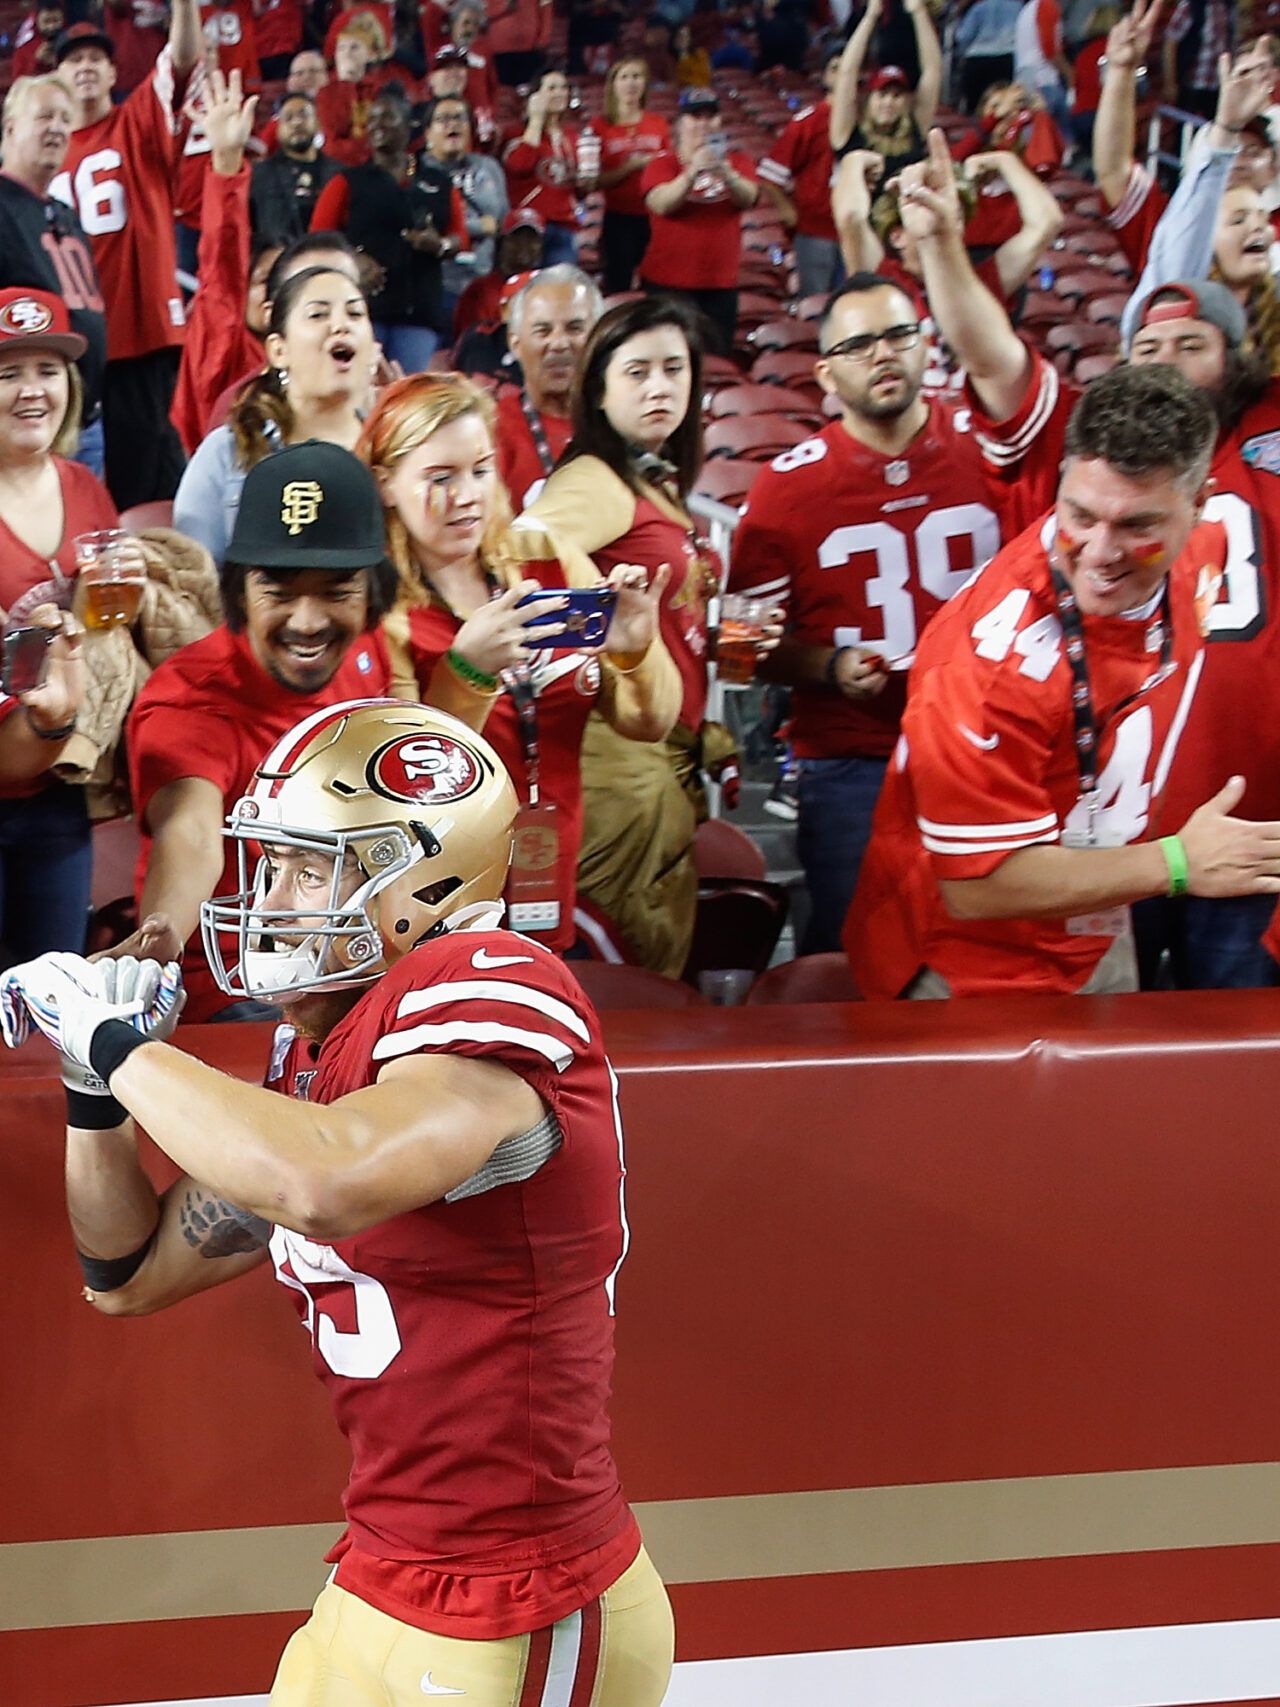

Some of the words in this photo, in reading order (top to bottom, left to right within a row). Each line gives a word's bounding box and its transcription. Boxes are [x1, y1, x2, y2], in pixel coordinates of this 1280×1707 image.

[40, 231, 105, 313] 10
[281, 481, 324, 535] SF
[971, 588, 1063, 683] 44
